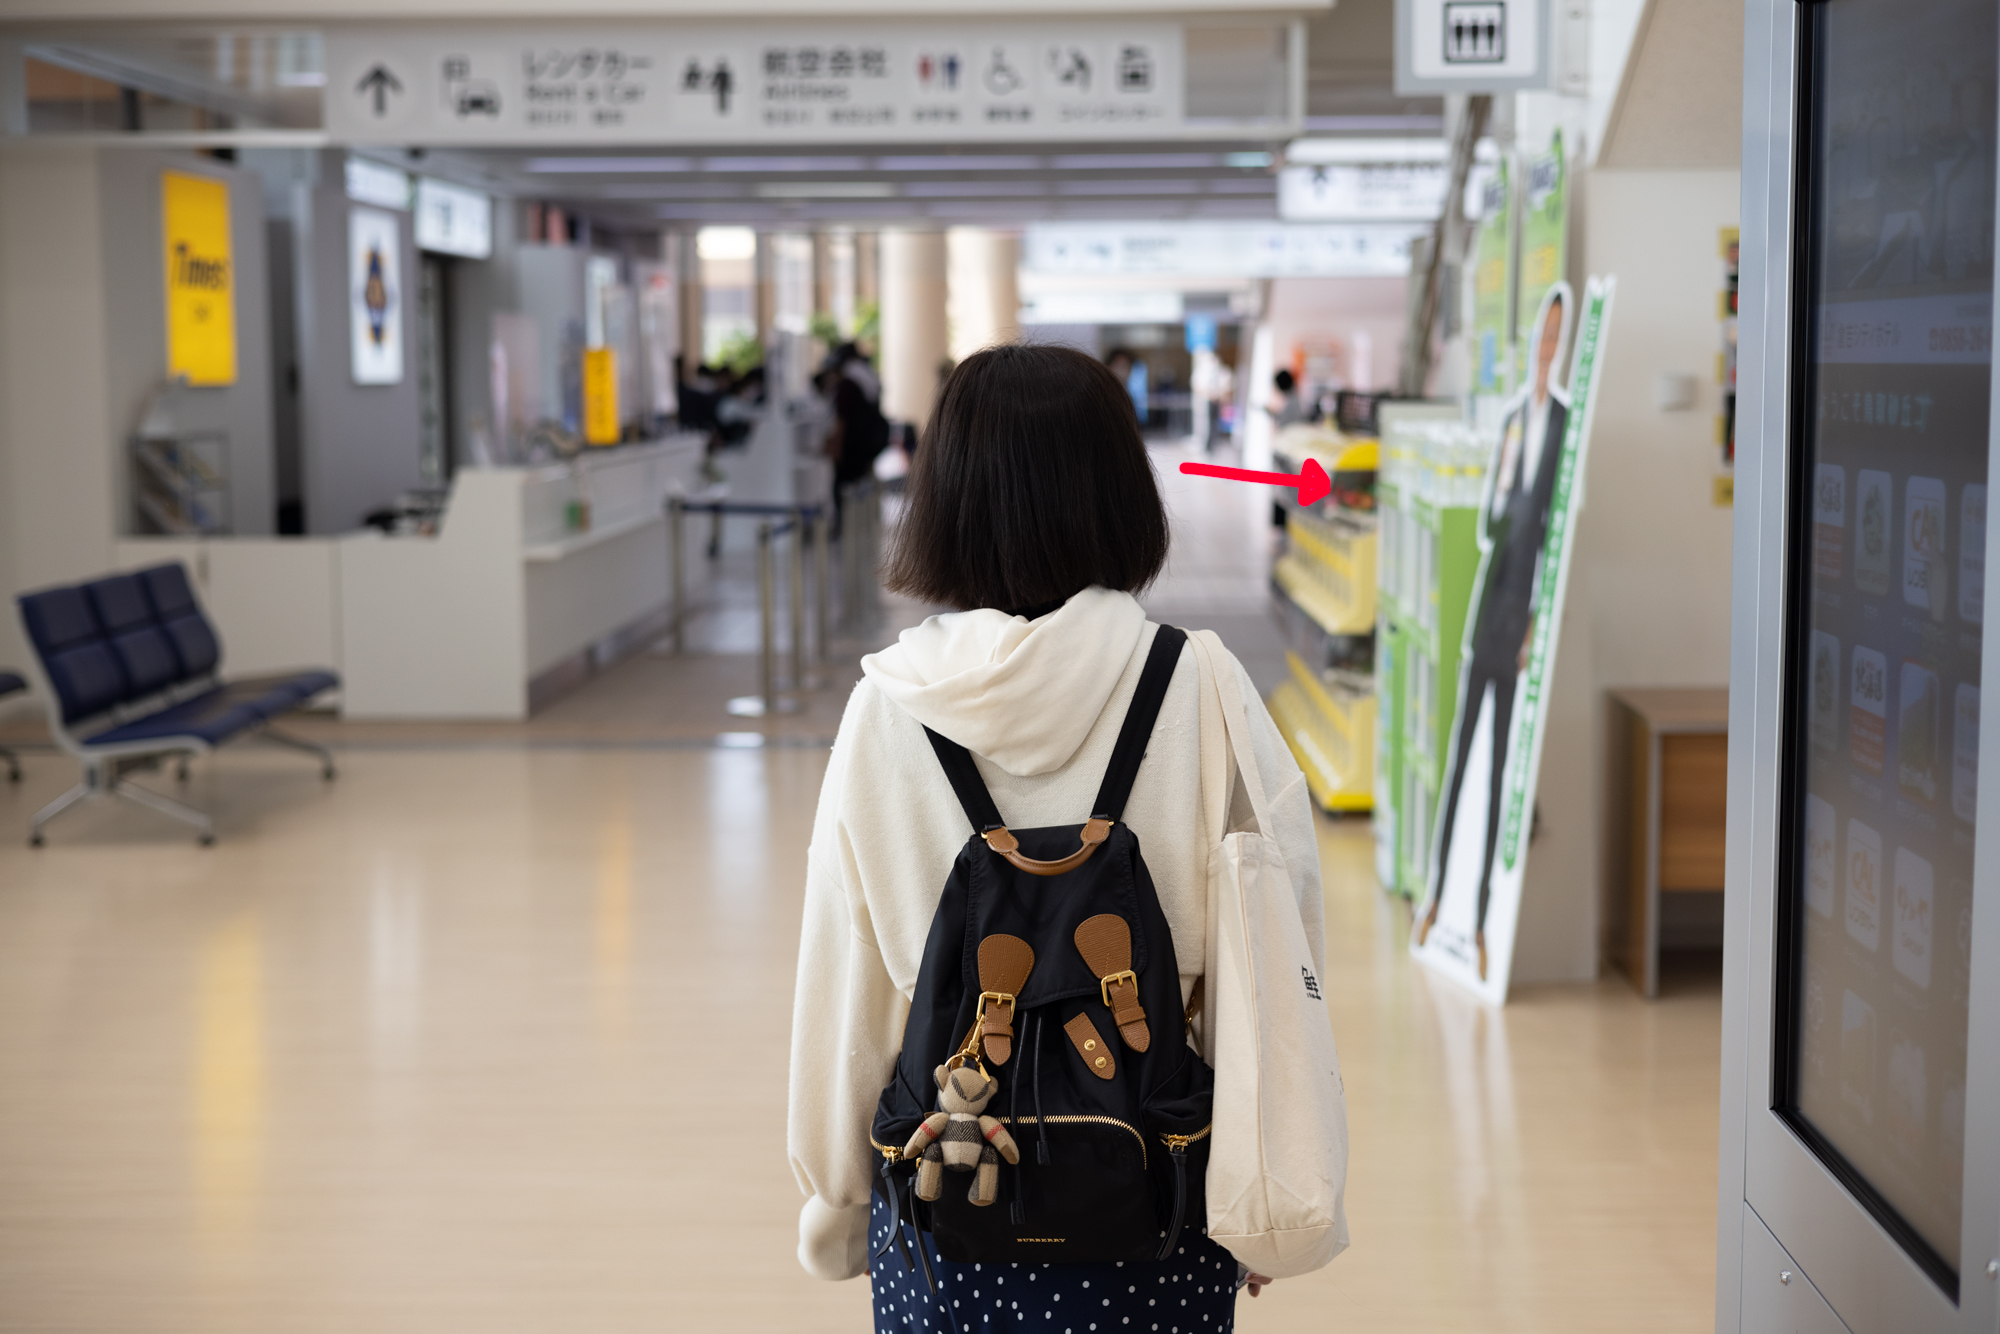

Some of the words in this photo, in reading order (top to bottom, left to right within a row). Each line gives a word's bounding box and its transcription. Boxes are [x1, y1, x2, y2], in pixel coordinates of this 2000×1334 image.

[523, 48, 654, 79] レンタカー
[761, 48, 888, 79] 航空会社
[524, 81, 579, 102] Rent
[605, 81, 647, 102] Car
[762, 81, 850, 102] Airlines
[172, 240, 229, 291] Times
